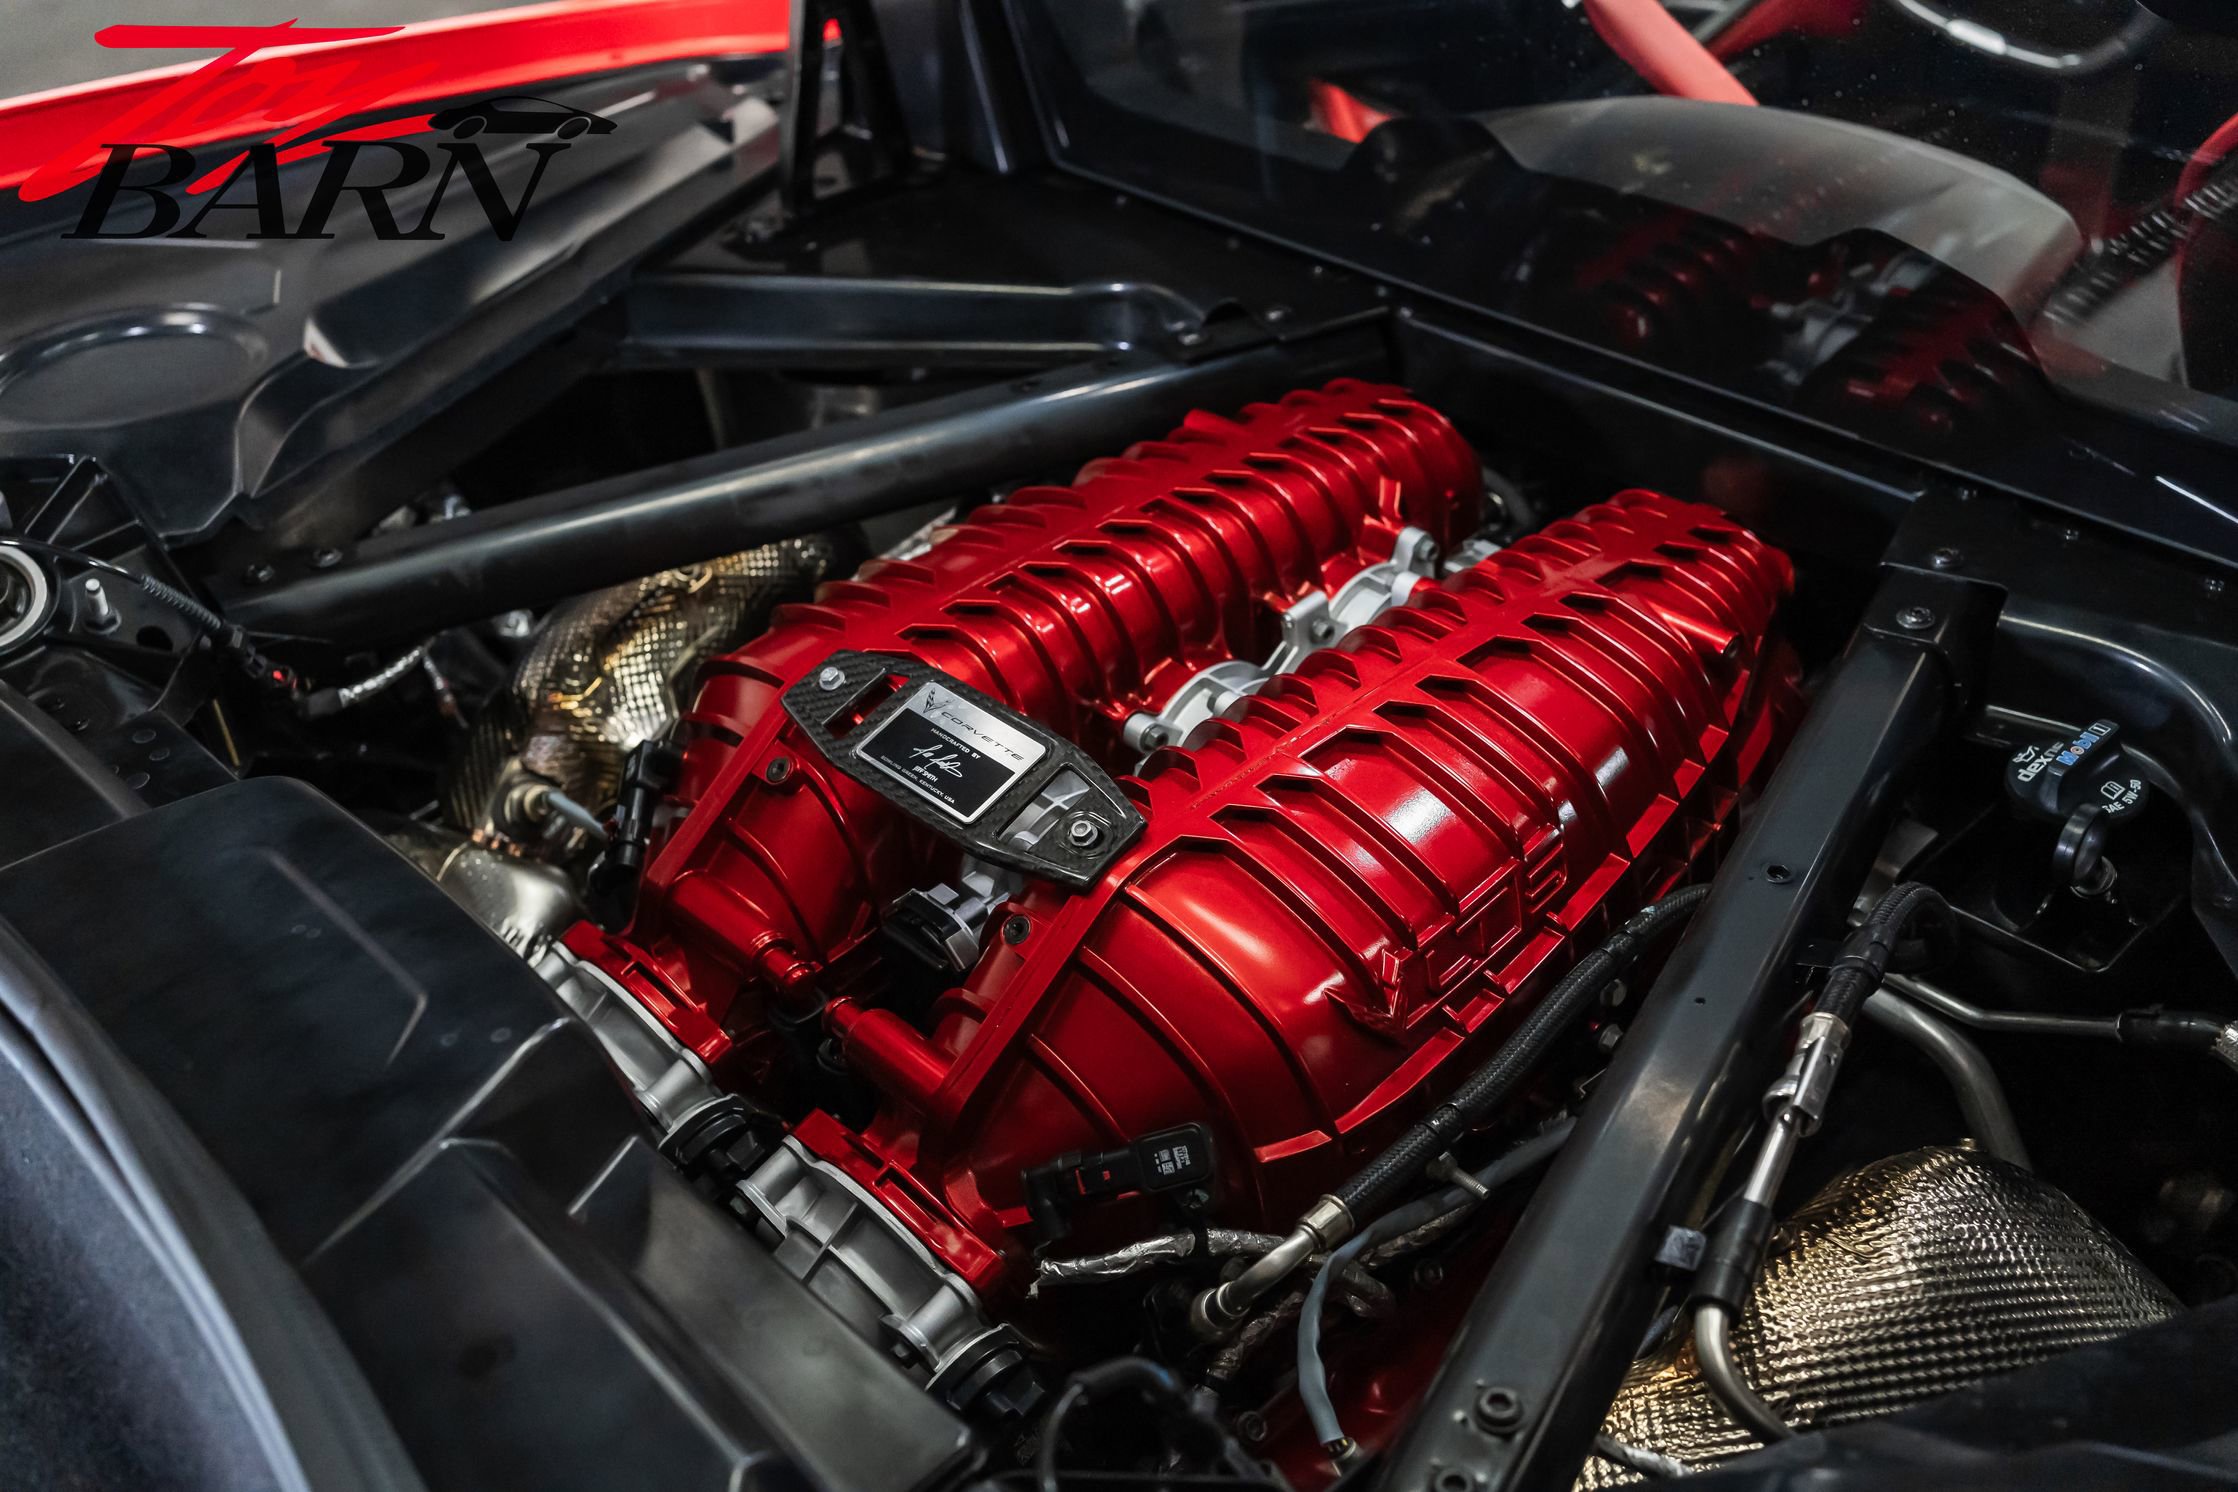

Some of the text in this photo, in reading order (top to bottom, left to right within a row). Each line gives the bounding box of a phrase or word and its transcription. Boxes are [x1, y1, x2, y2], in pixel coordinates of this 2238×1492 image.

[930, 728, 981, 760] HANDCRAFTED BY
[941, 711, 1024, 761] CORVETTE
[2056, 731, 2099, 766] Mobil
[944, 795, 955, 804] USA
